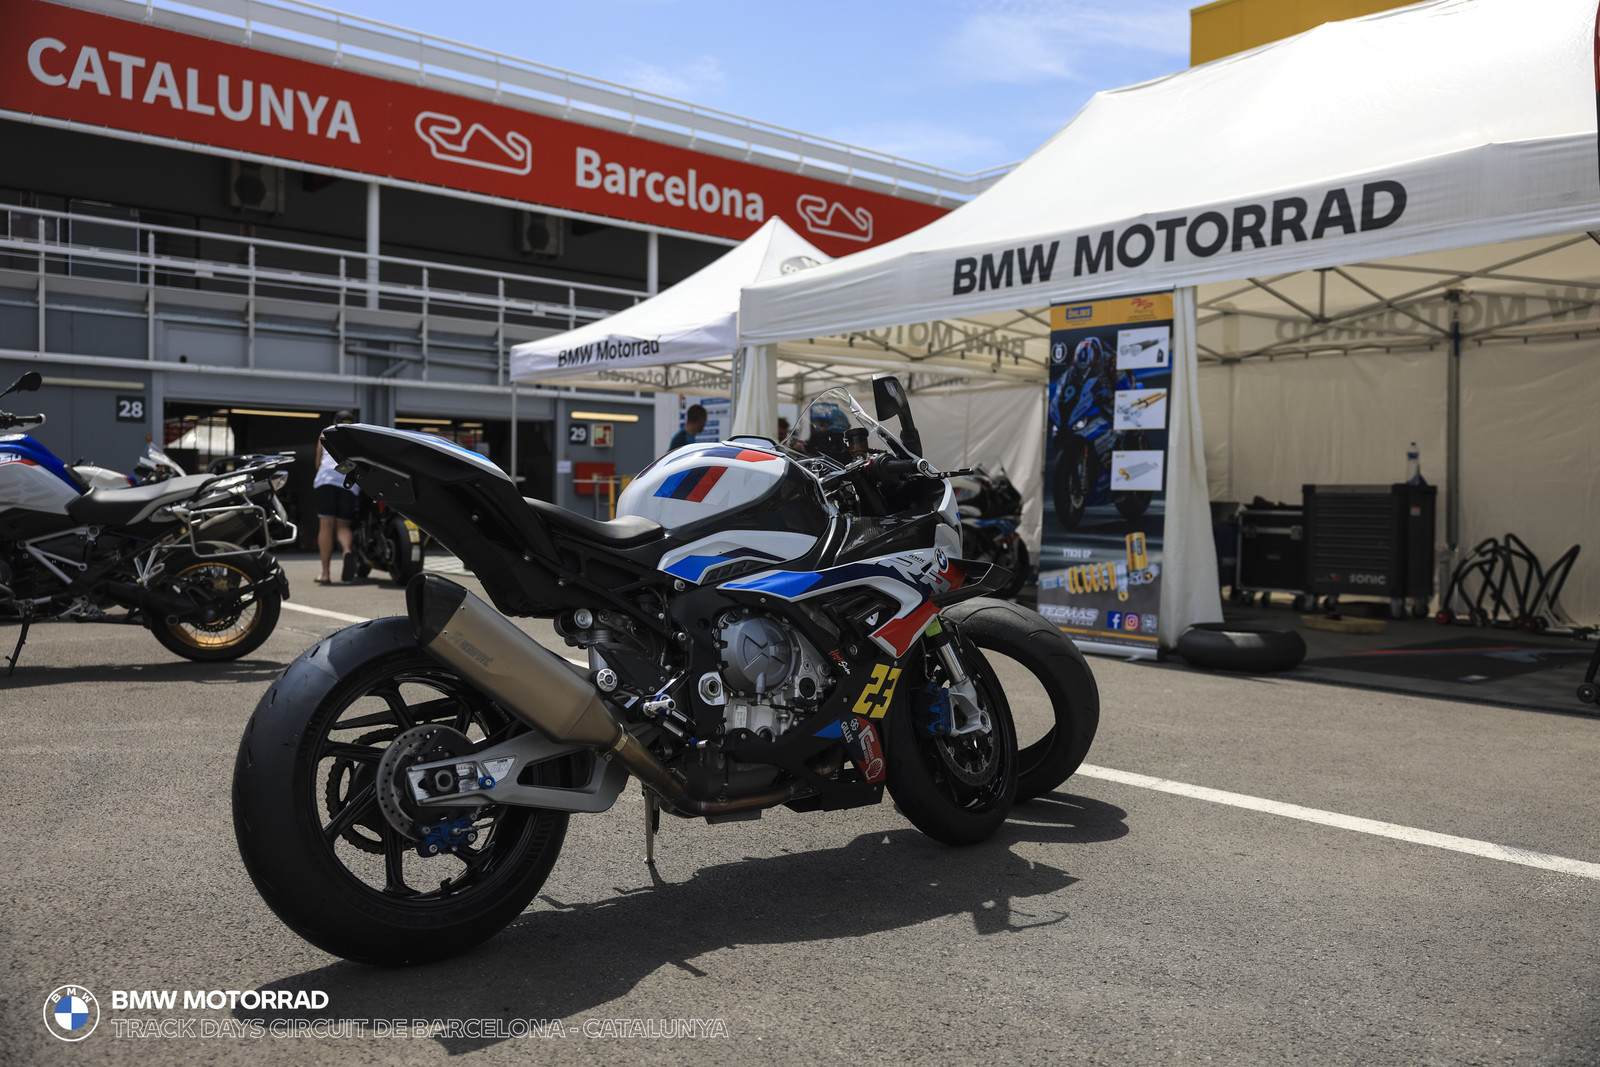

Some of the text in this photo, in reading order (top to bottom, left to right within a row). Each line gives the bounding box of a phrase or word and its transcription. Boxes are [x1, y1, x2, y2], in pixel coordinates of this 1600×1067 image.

[27, 37, 361, 145] CATALUNYA
[575, 147, 764, 222] Barcelona
[953, 179, 1407, 295] BMW MOTORRAD
[558, 336, 661, 367] BMW Motorrad
[118, 400, 144, 418] 28
[570, 427, 586, 441] 29
[1039, 605, 1099, 620] TECMAS
[852, 663, 903, 719] 23
[841, 721, 854, 744] GILLES
